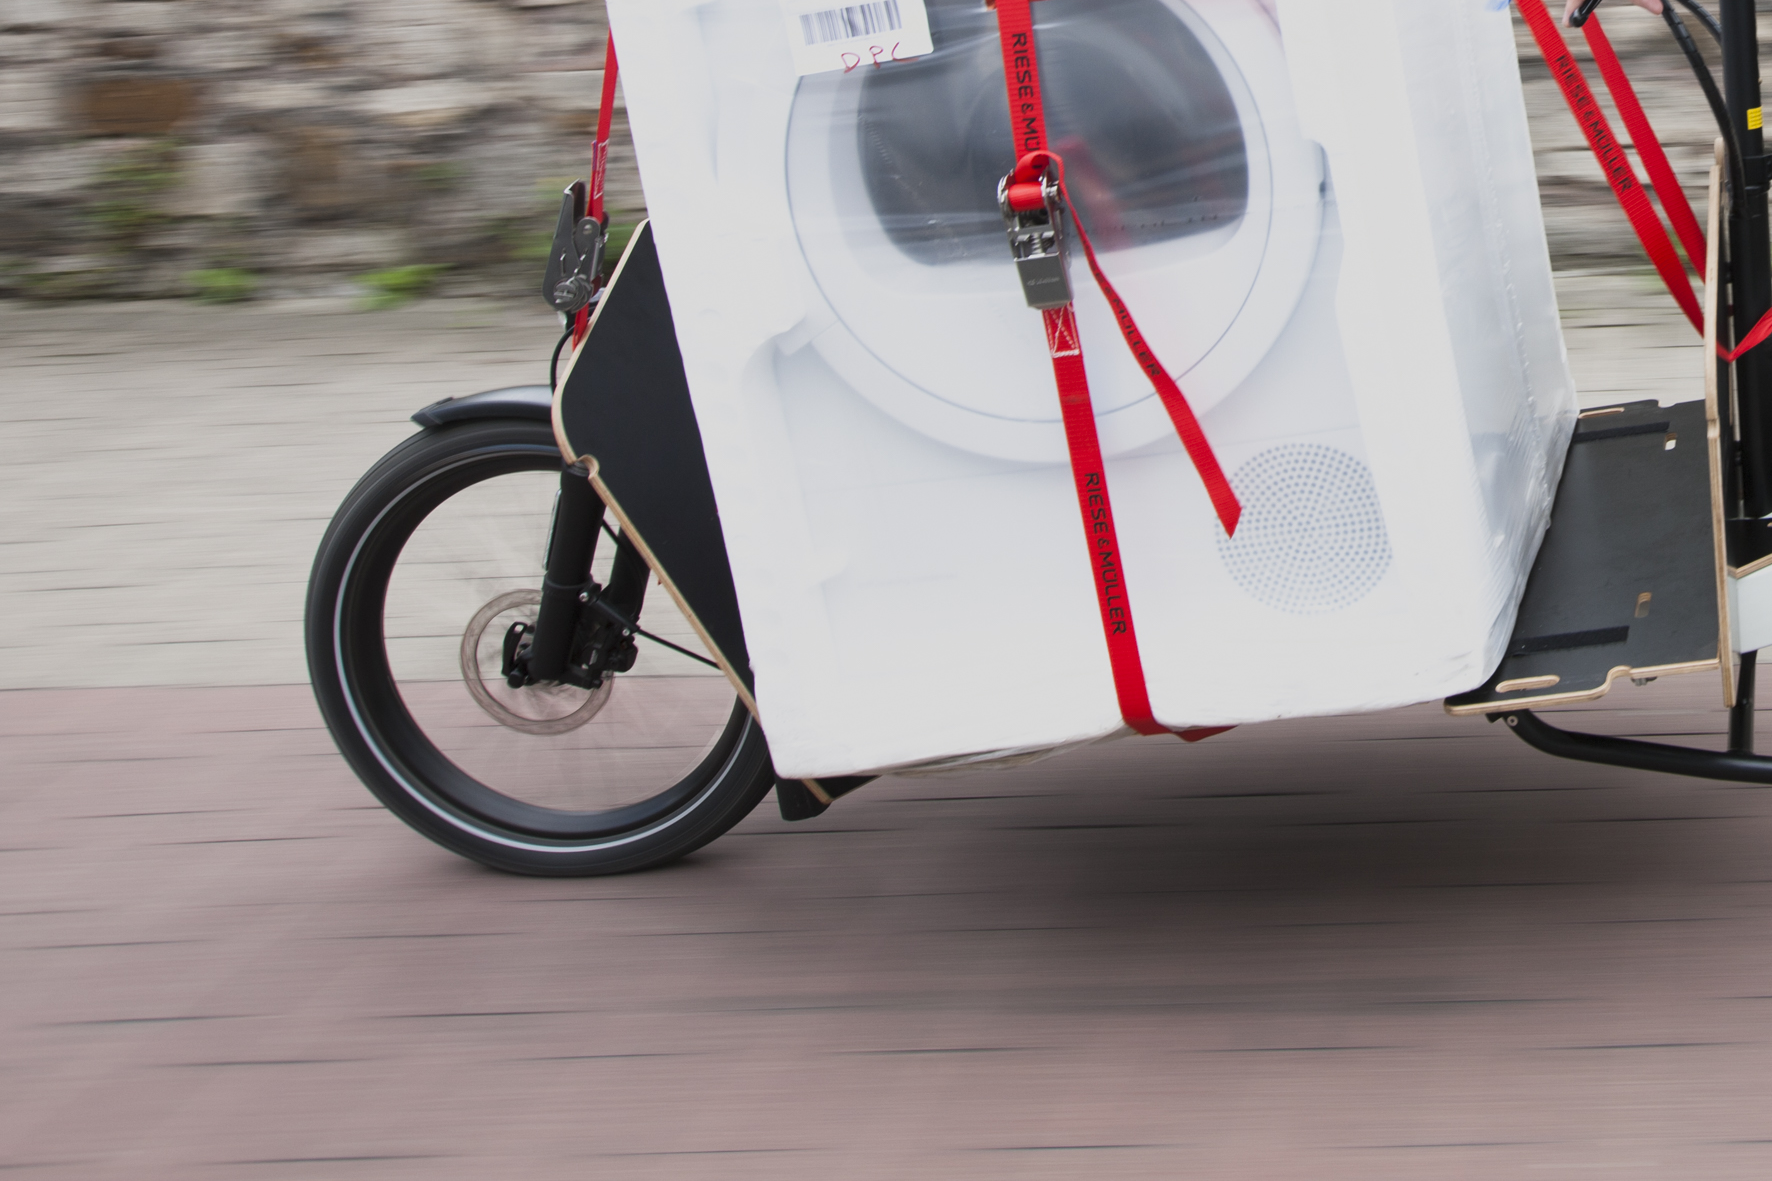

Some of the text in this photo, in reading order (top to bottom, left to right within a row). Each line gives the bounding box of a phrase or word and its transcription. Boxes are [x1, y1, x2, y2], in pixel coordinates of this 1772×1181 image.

[1011, 32, 1034, 99] RIESE
[1021, 102, 1035, 115] &
[1555, 54, 1592, 111] RIESE
[1588, 119, 1633, 194] MÜLLER
[1084, 471, 1128, 636] RIESE & MÜLLER
